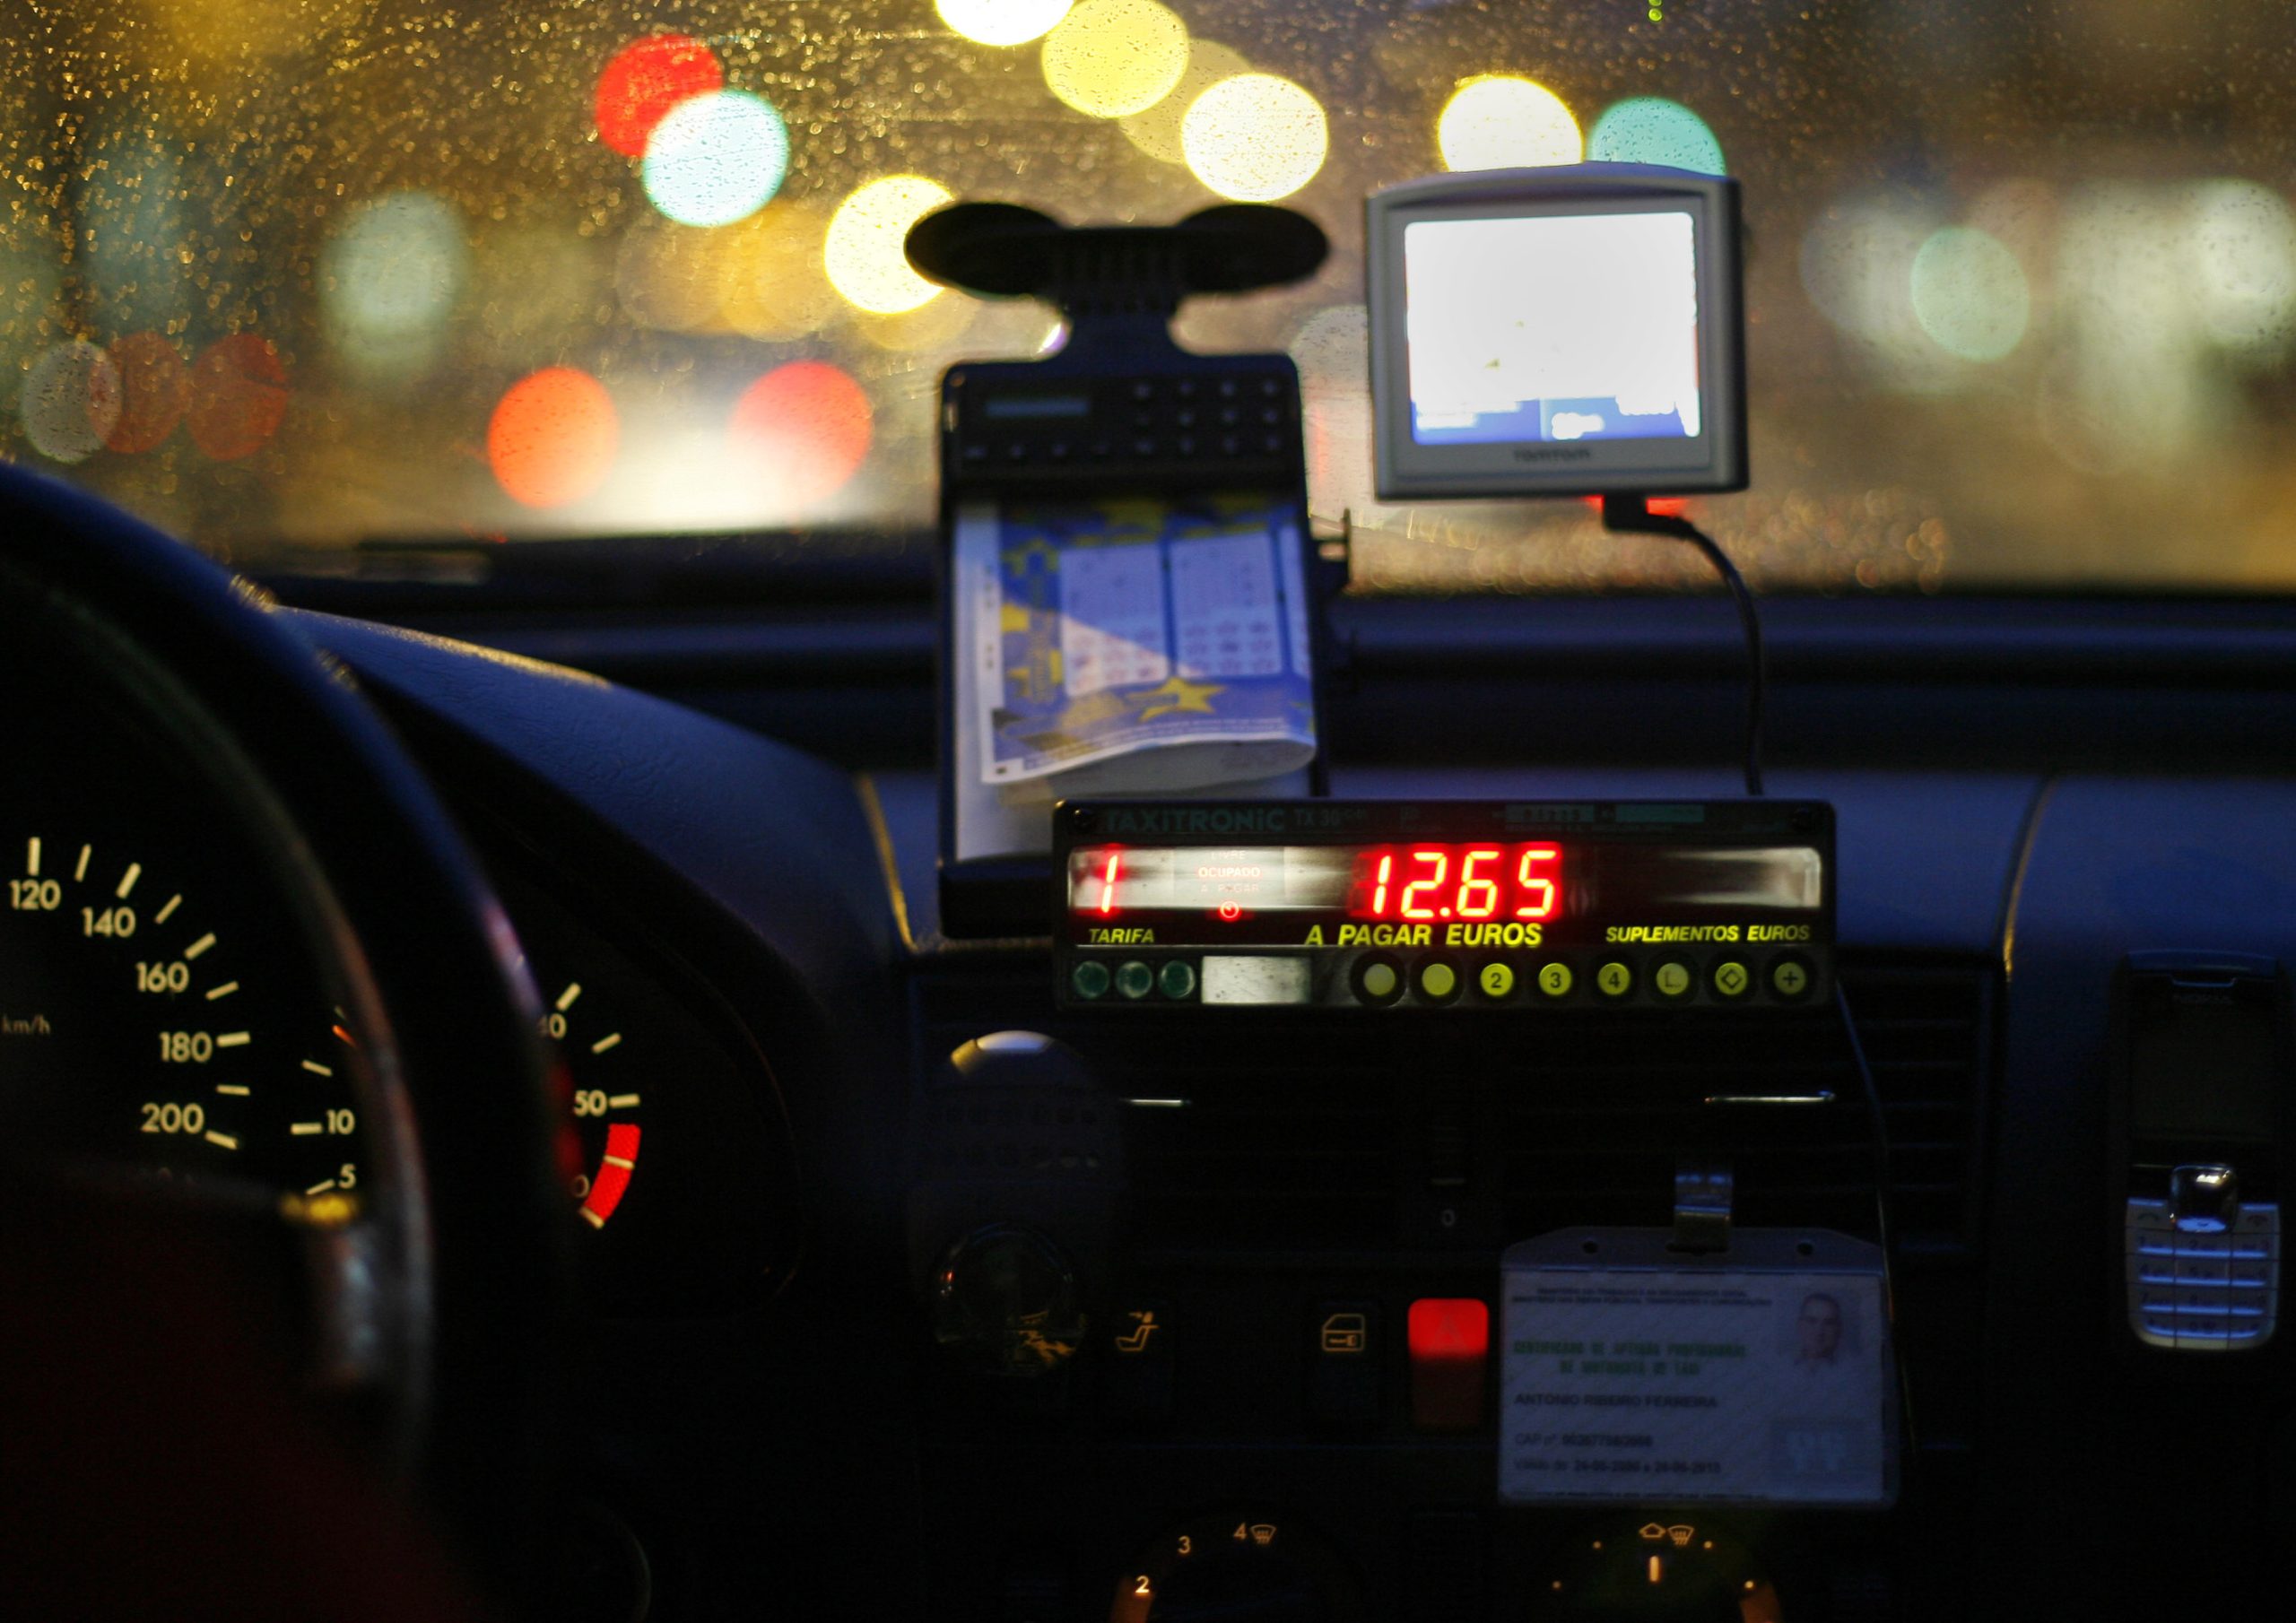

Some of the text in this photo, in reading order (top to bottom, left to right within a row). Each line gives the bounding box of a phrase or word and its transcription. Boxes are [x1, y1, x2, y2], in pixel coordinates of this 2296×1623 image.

[1198, 866, 1261, 878] OCUPADO
[9, 879, 62, 911] 120
[1100, 854, 1120, 915] 1
[1371, 849, 1558, 920] 12.65
[81, 906, 136, 938] 140
[1605, 924, 1812, 943] SUPLEMENTOS EUROS
[1089, 927, 1155, 944] TARIFA
[1305, 922, 1544, 948] A PAGAR EUROS
[135, 960, 190, 994] 160
[1491, 973, 1502, 988] 2
[1550, 973, 1561, 988] 3
[1607, 972, 1620, 988] 4
[2, 1014, 51, 1036] km/h
[159, 1030, 213, 1063] 180
[573, 1089, 608, 1118] 50
[141, 1103, 205, 1135] 200
[326, 1107, 356, 1135] 10
[338, 1165, 357, 1189] 5
[1232, 1522, 1248, 1541] 4
[1178, 1535, 1192, 1556] 3
[1135, 1575, 1151, 1595] 2
